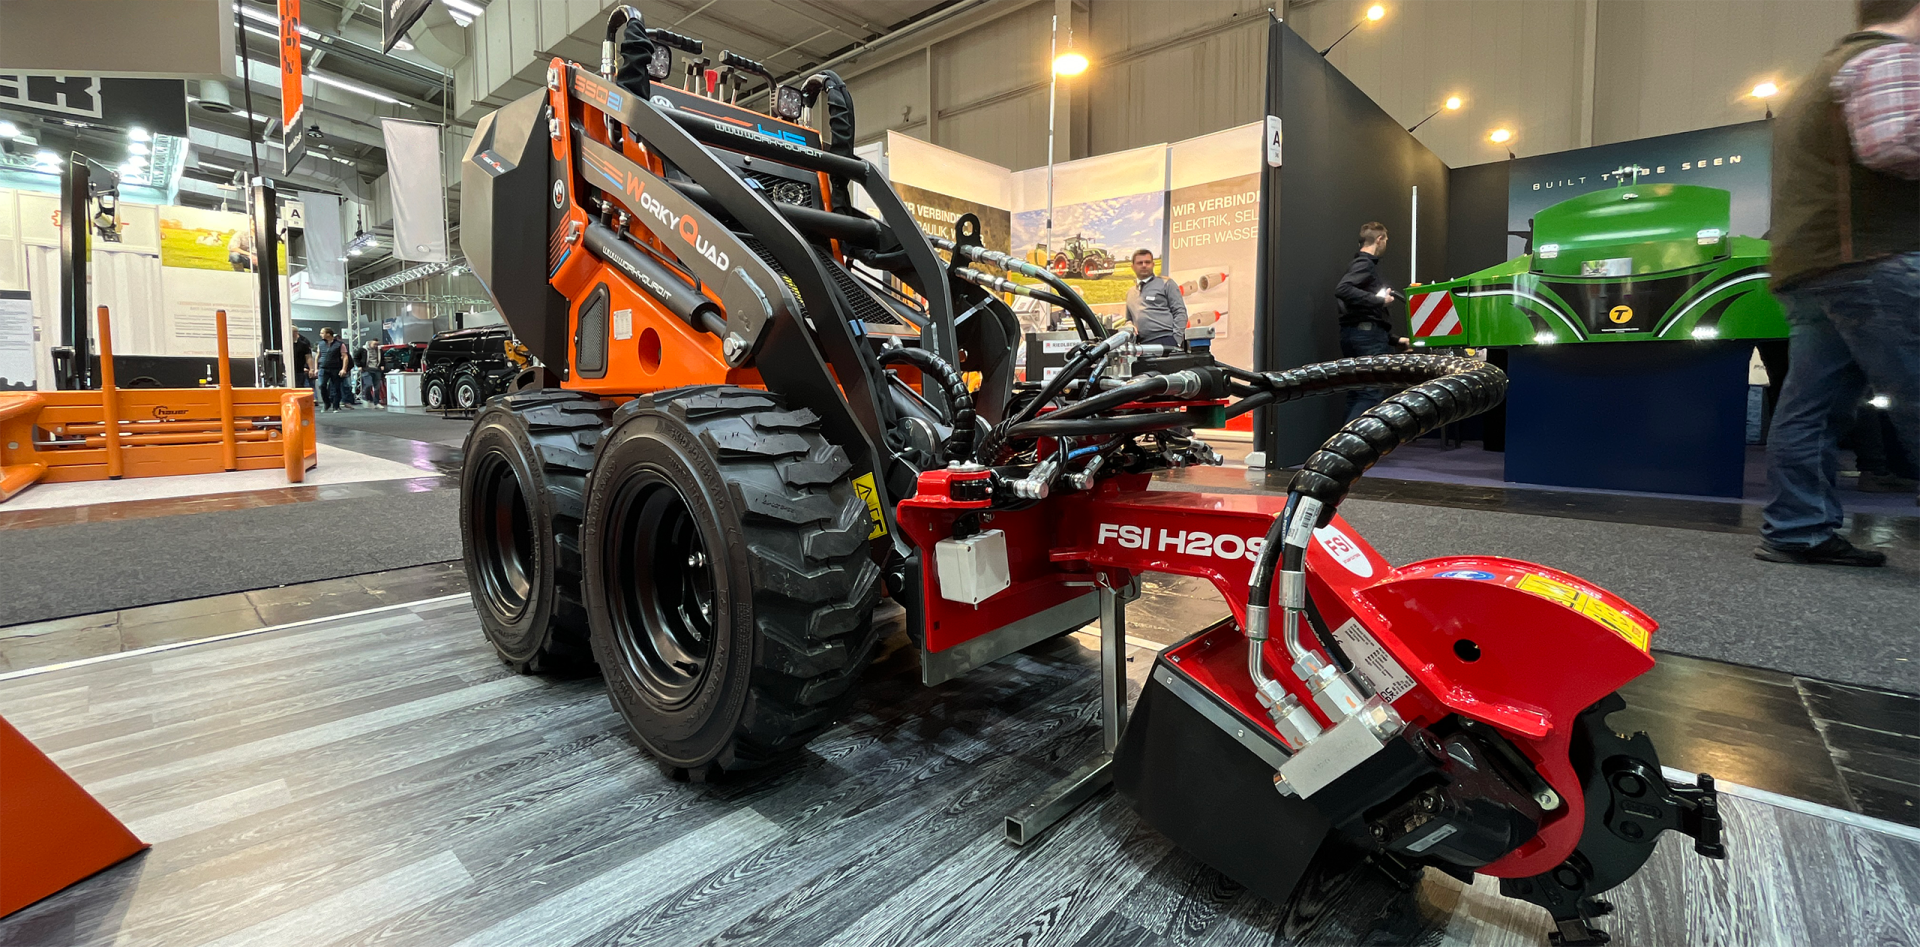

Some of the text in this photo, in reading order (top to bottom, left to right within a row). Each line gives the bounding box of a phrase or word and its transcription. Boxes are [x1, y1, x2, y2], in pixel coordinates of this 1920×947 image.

[1273, 131, 1280, 147] A
[1532, 177, 1586, 190] BUILT
[1641, 165, 1666, 176] BE
[1681, 155, 1742, 171] SEEN
[291, 208, 301, 219] A
[1172, 202, 1196, 217] WIR
[1172, 213, 1231, 233] ELEKTRIK,
[1172, 233, 1211, 249] UNTER
[1614, 309, 1629, 321] T
[158, 408, 189, 416] hauer
[1098, 523, 1151, 549] FSI
[1323, 535, 1354, 556] FSI
